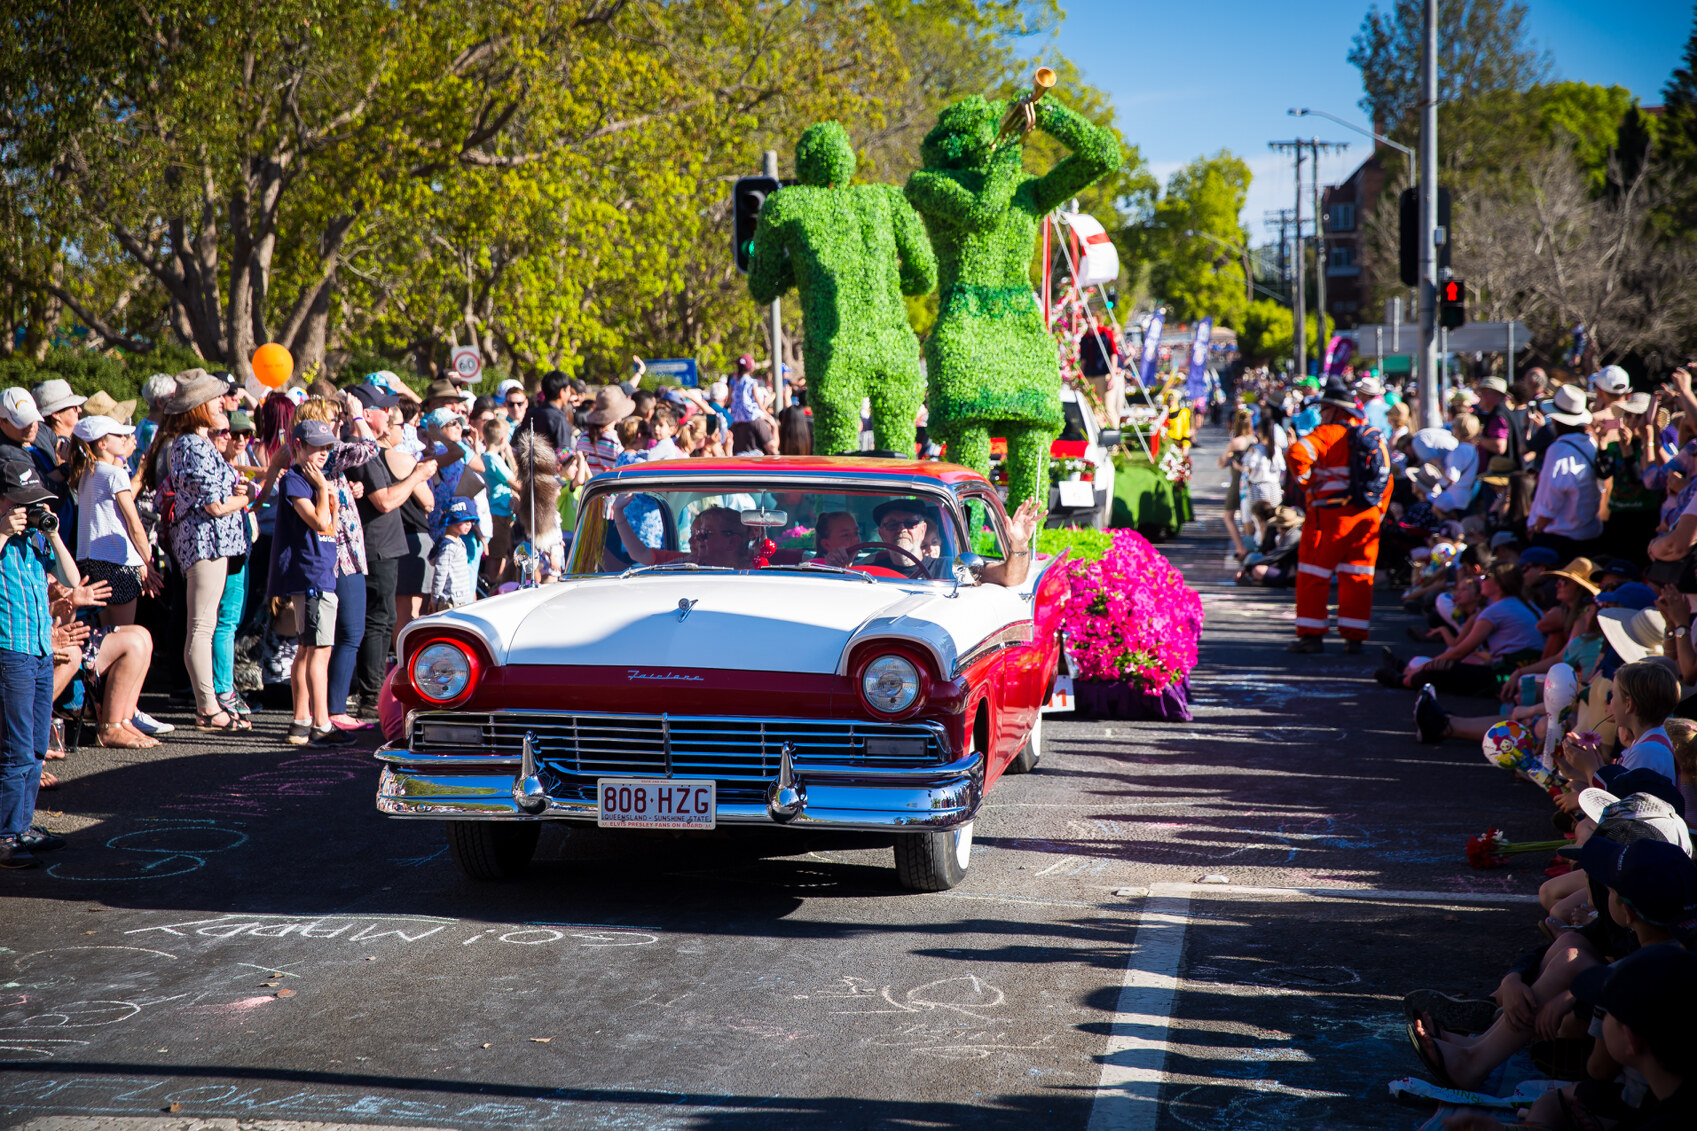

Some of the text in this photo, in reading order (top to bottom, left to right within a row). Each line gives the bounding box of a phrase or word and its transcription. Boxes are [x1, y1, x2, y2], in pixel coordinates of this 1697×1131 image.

[459, 358, 476, 372] 60
[627, 669, 705, 681] Fairlane
[604, 813, 710, 823] QUEENSLAND SUNSHINE STATE
